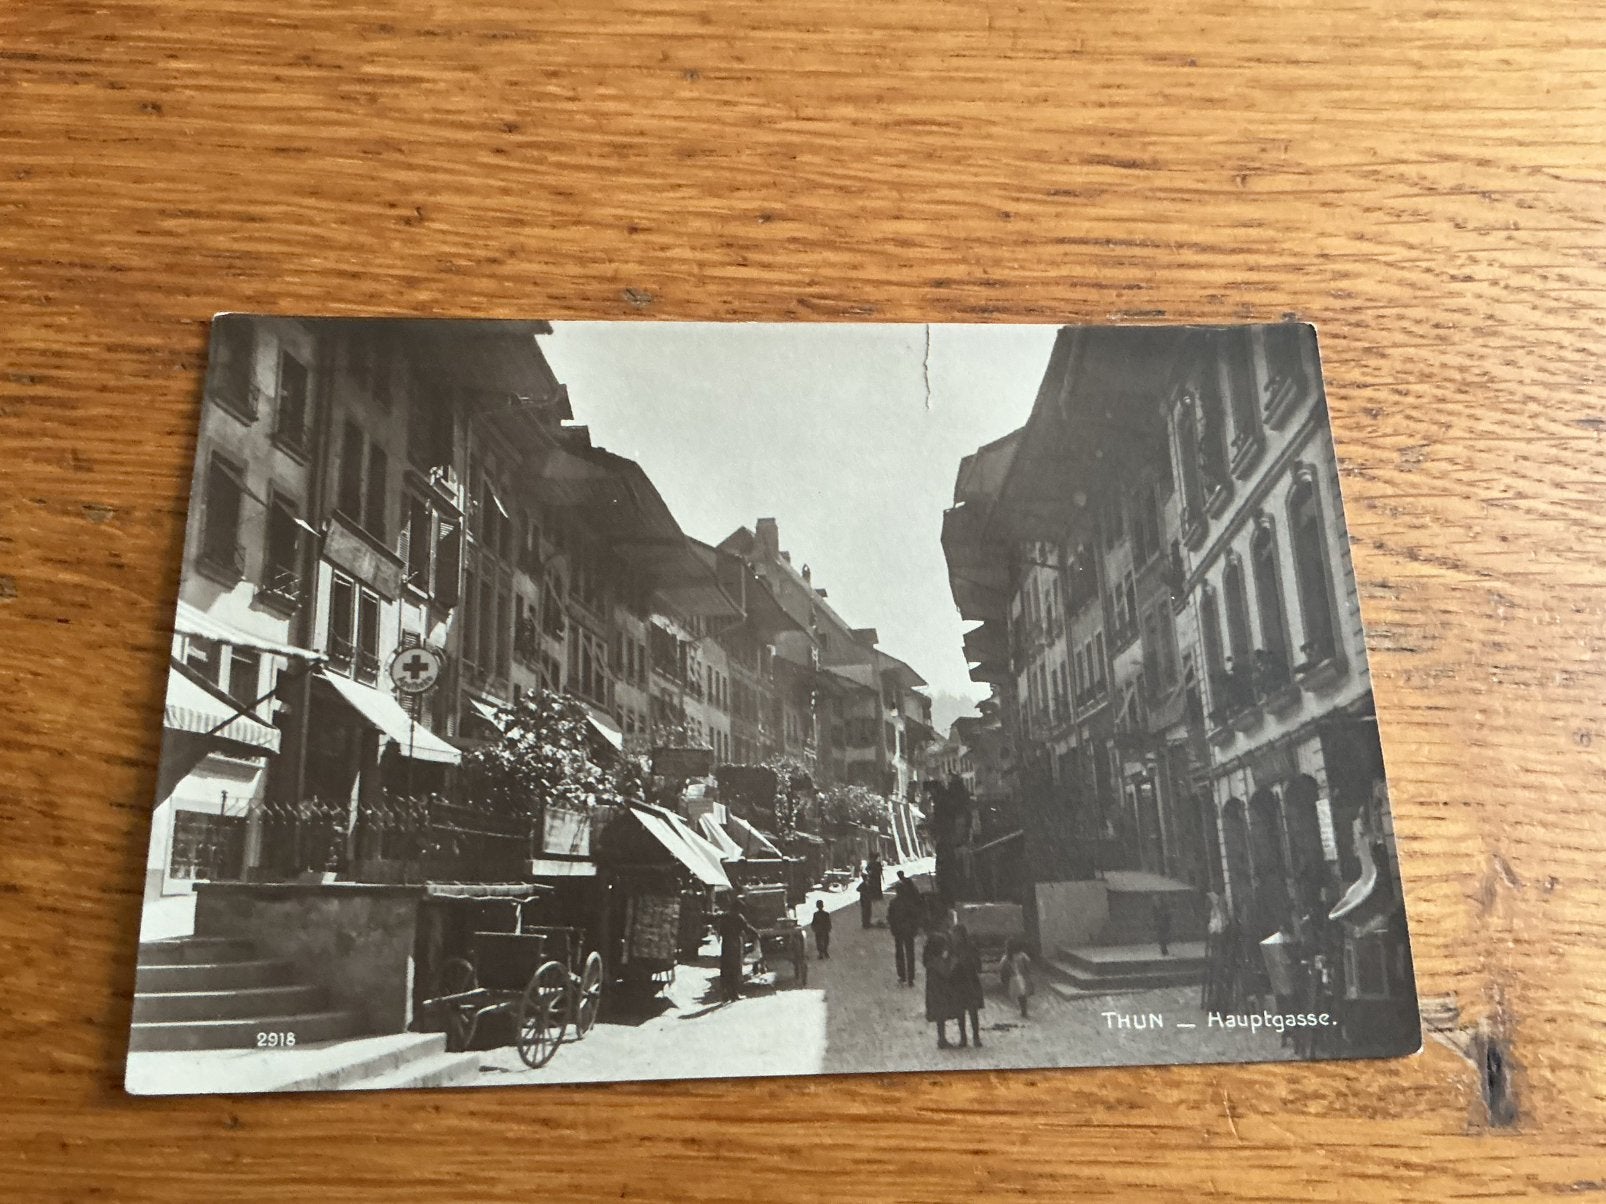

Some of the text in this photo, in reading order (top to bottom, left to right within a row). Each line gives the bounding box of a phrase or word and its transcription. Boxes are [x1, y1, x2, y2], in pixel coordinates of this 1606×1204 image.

[1101, 1011, 1164, 1030] THUN
[1207, 1009, 1338, 1034] Hauptgasse.
[256, 1031, 296, 1047] 2918
